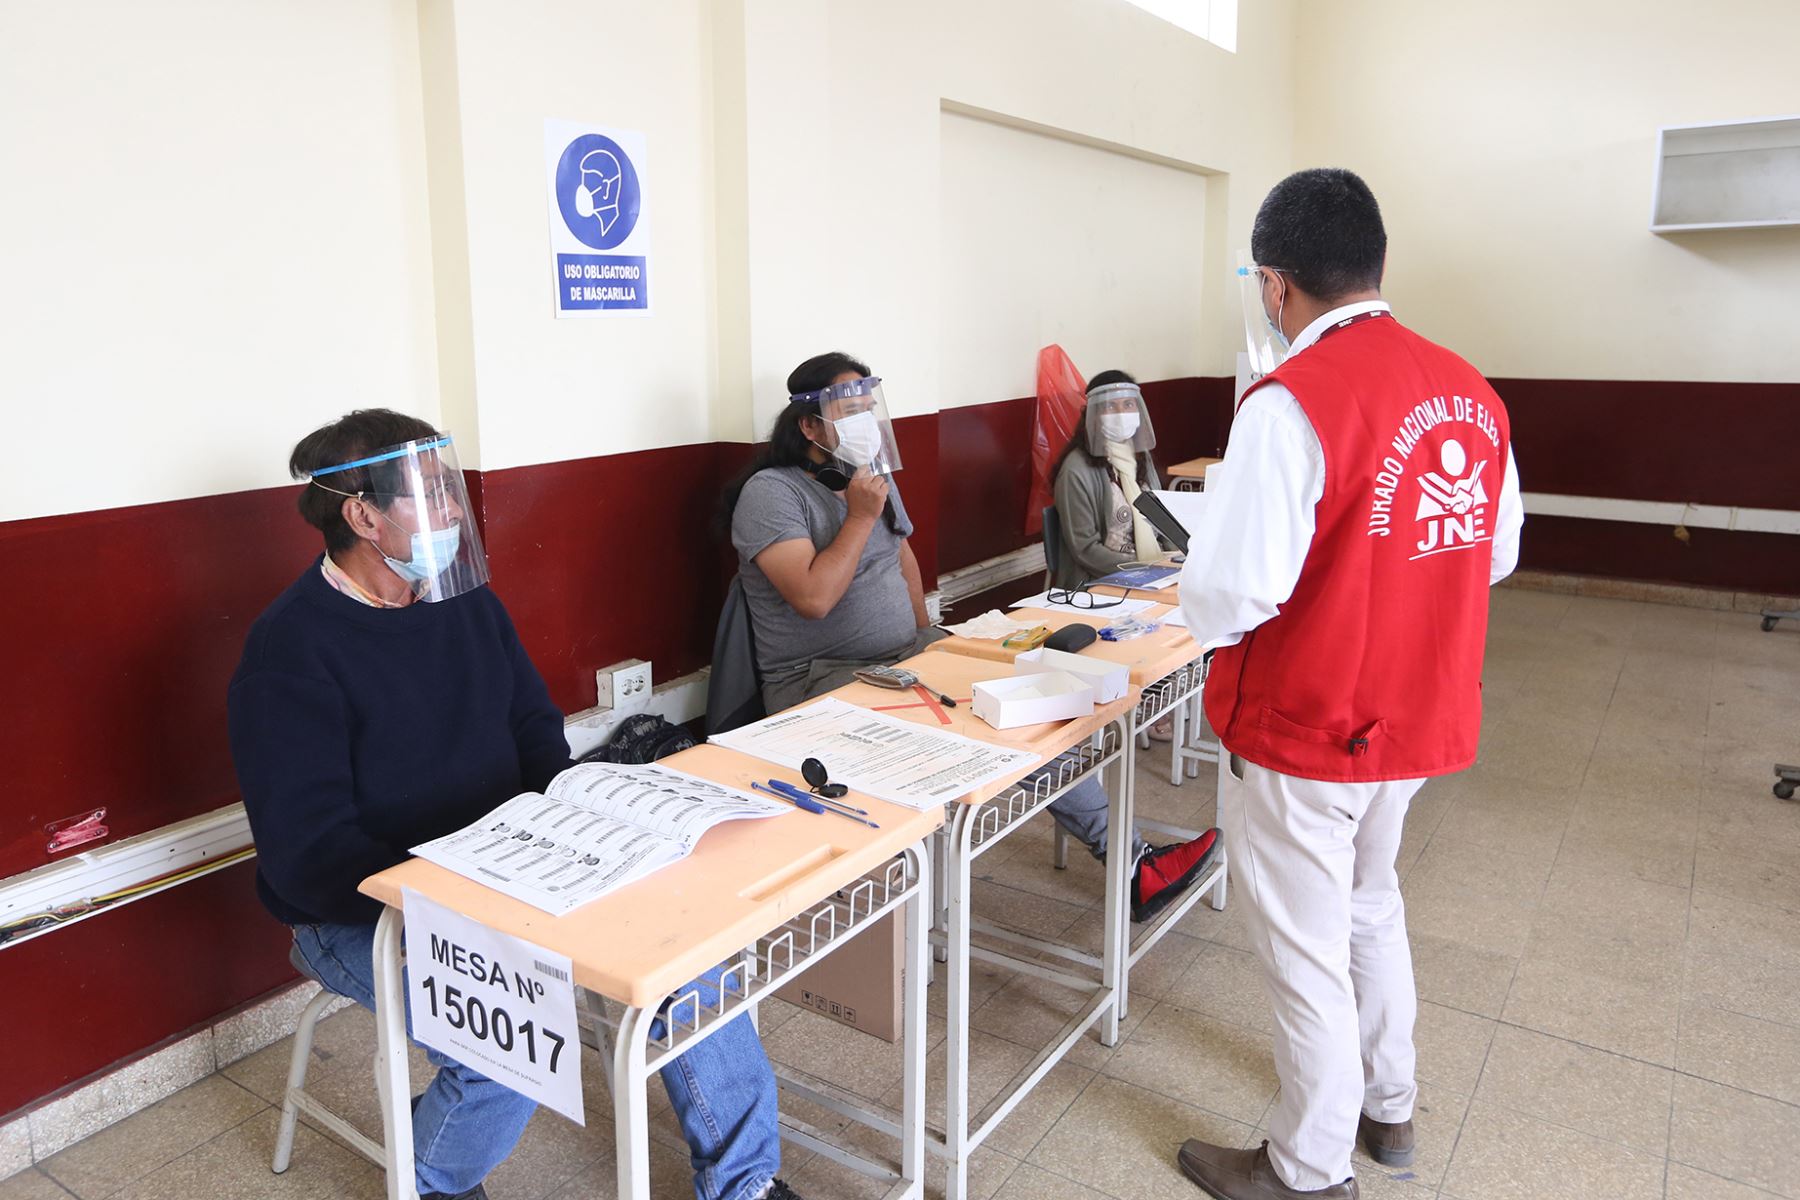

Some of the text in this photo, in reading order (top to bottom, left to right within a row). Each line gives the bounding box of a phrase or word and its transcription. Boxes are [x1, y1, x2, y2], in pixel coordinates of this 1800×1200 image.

[564, 264, 640, 280] USO OBLIGATORIO
[570, 286, 637, 301] DE MASCARILLA
[1367, 456, 1404, 537] JURADO
[1391, 396, 1453, 460] NACIONAL
[1452, 395, 1474, 423] DE
[1416, 507, 1486, 552] JNE
[430, 932, 510, 993] MESA
[422, 975, 566, 1074] 150017
